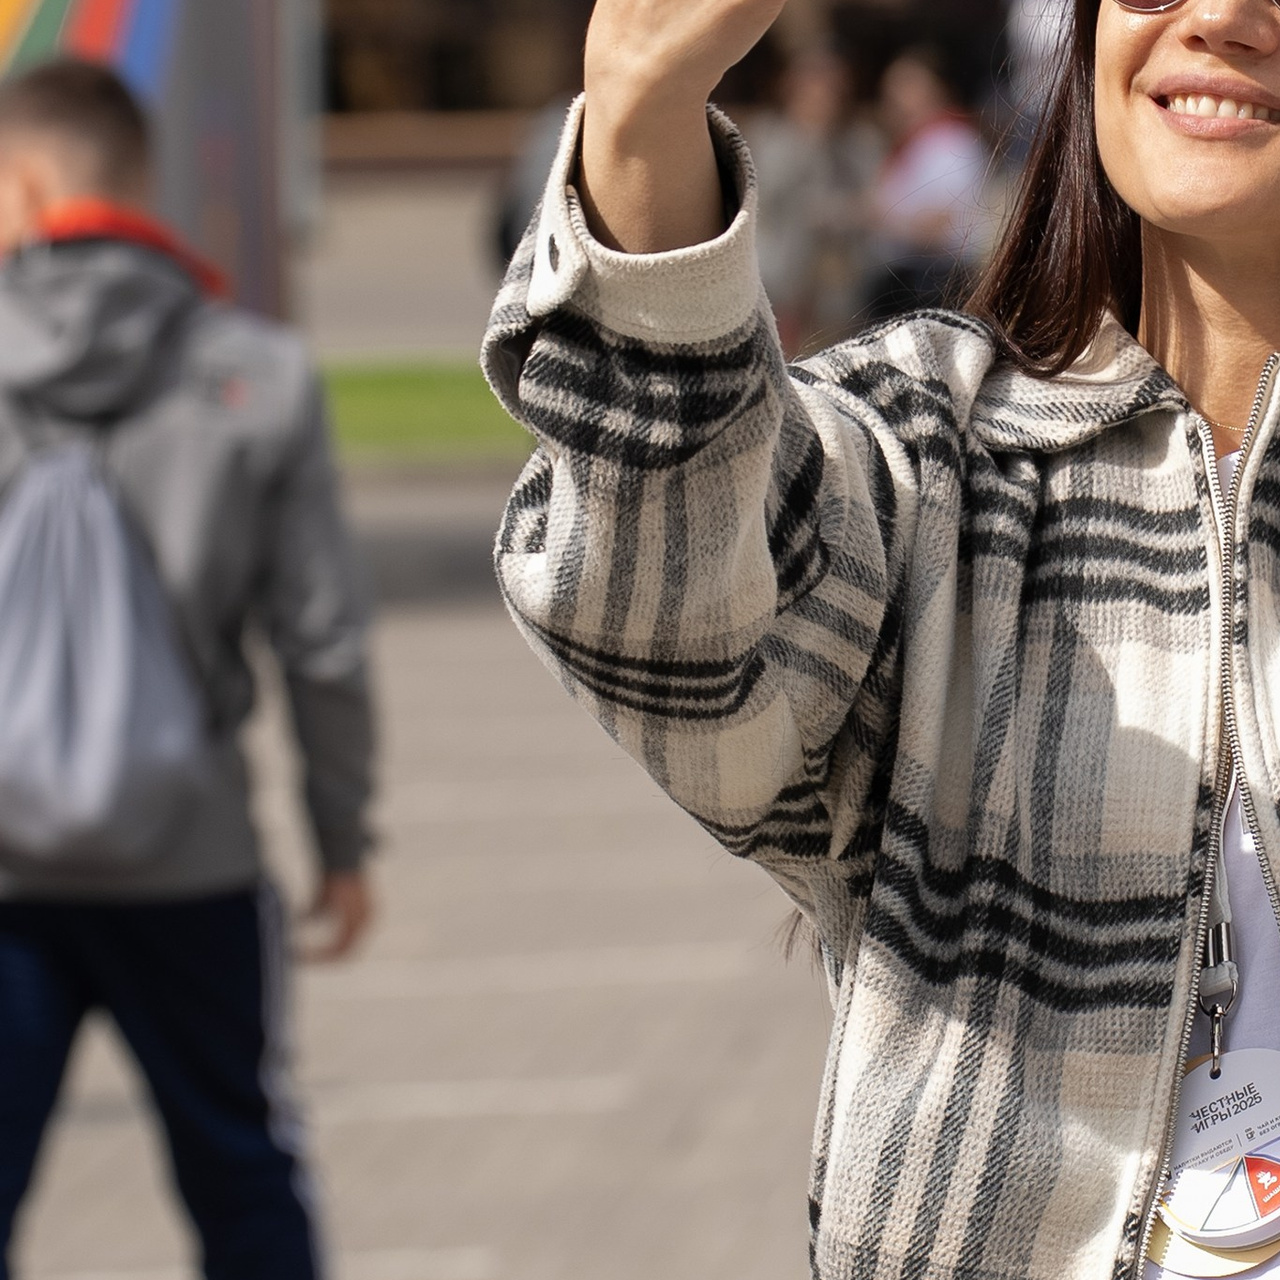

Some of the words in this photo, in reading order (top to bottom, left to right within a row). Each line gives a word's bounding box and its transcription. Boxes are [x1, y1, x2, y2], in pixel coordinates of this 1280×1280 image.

[1188, 1082, 1257, 1120] ЧЕСТНЫЕ
[1190, 1108, 1232, 1133] ИГРЫ
[1232, 1092, 1262, 1115] 2025
[1256, 1120, 1269, 1130] ЧАЙ
[1258, 1127, 1270, 1136] БЕЗ
